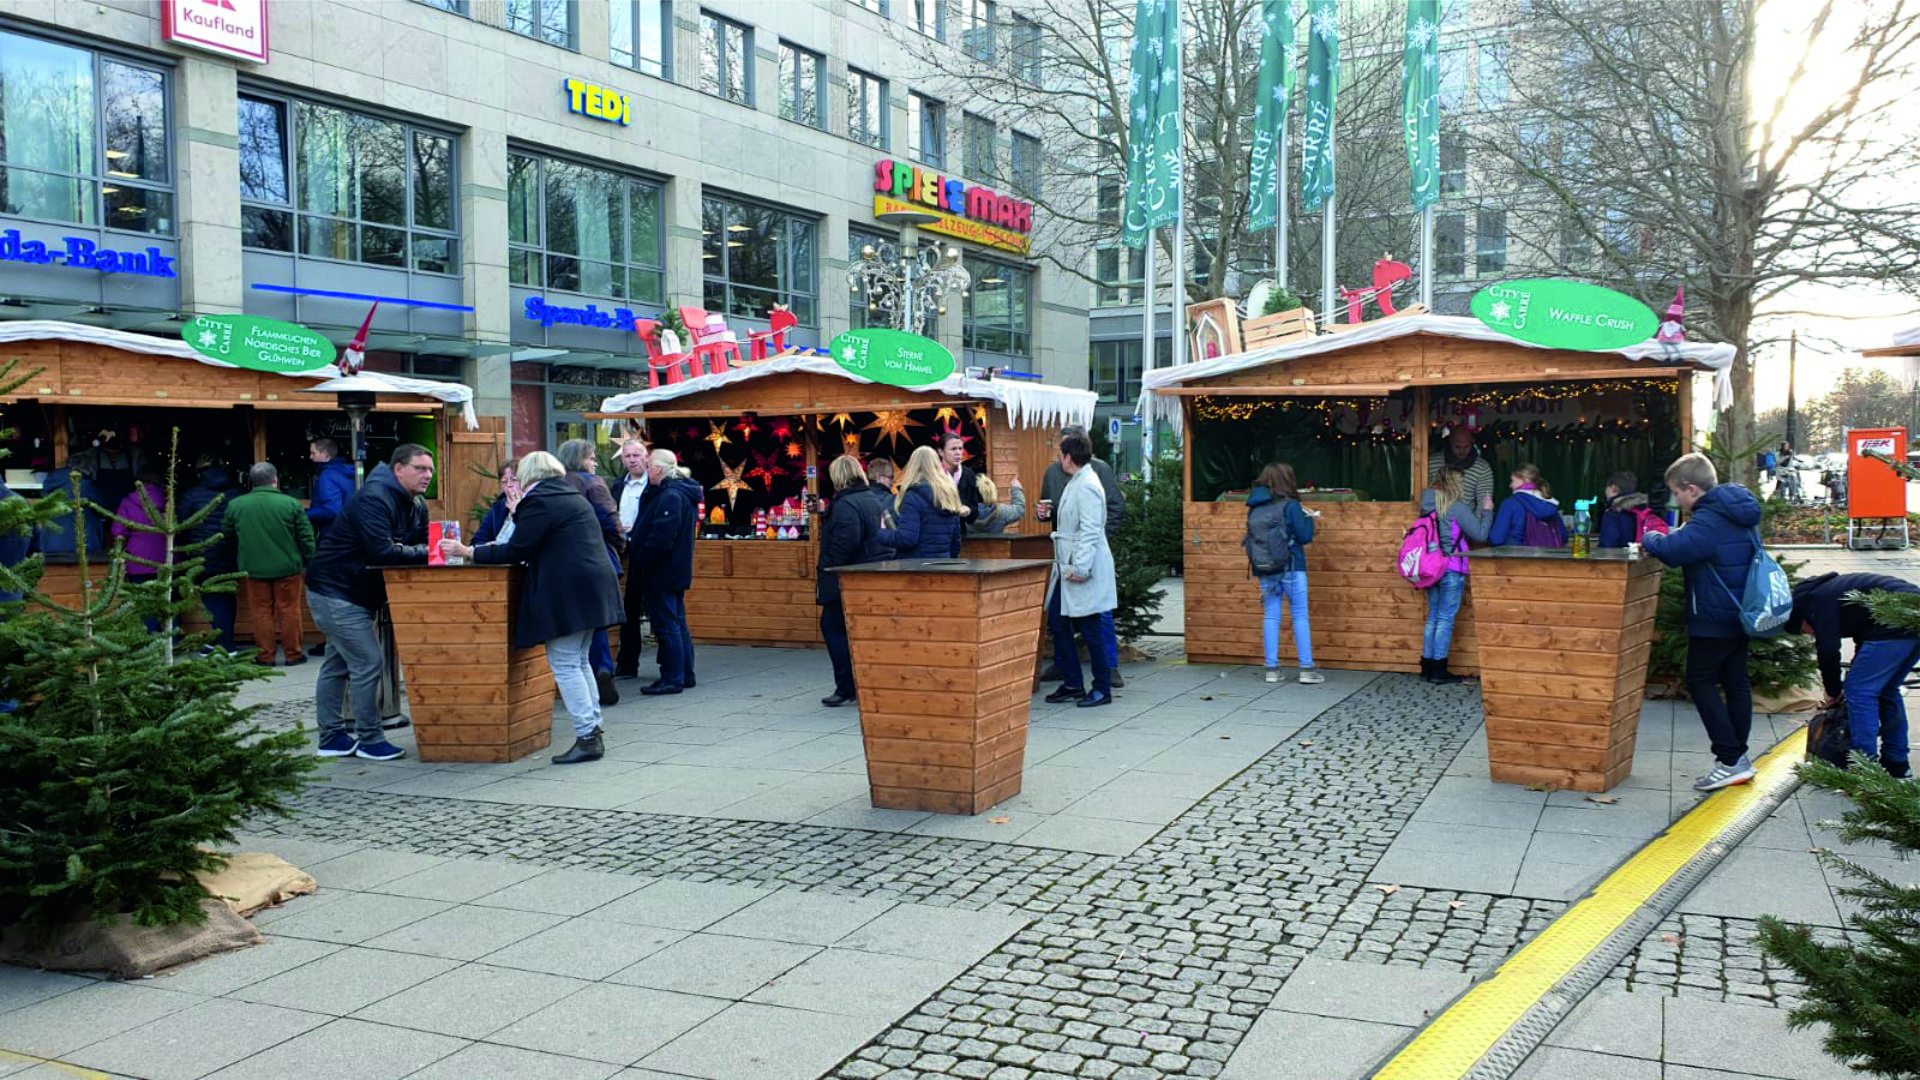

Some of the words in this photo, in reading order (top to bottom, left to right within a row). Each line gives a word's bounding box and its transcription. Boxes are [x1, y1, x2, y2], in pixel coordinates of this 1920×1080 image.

[182, 7, 255, 39] Kaufland
[564, 78, 632, 127] TEDi
[874, 159, 965, 213] SPIELE
[966, 186, 1033, 231] MAX
[1489, 286, 1520, 300] CITY
[196, 316, 225, 330] CITY
[525, 296, 637, 331] Sparda-B
